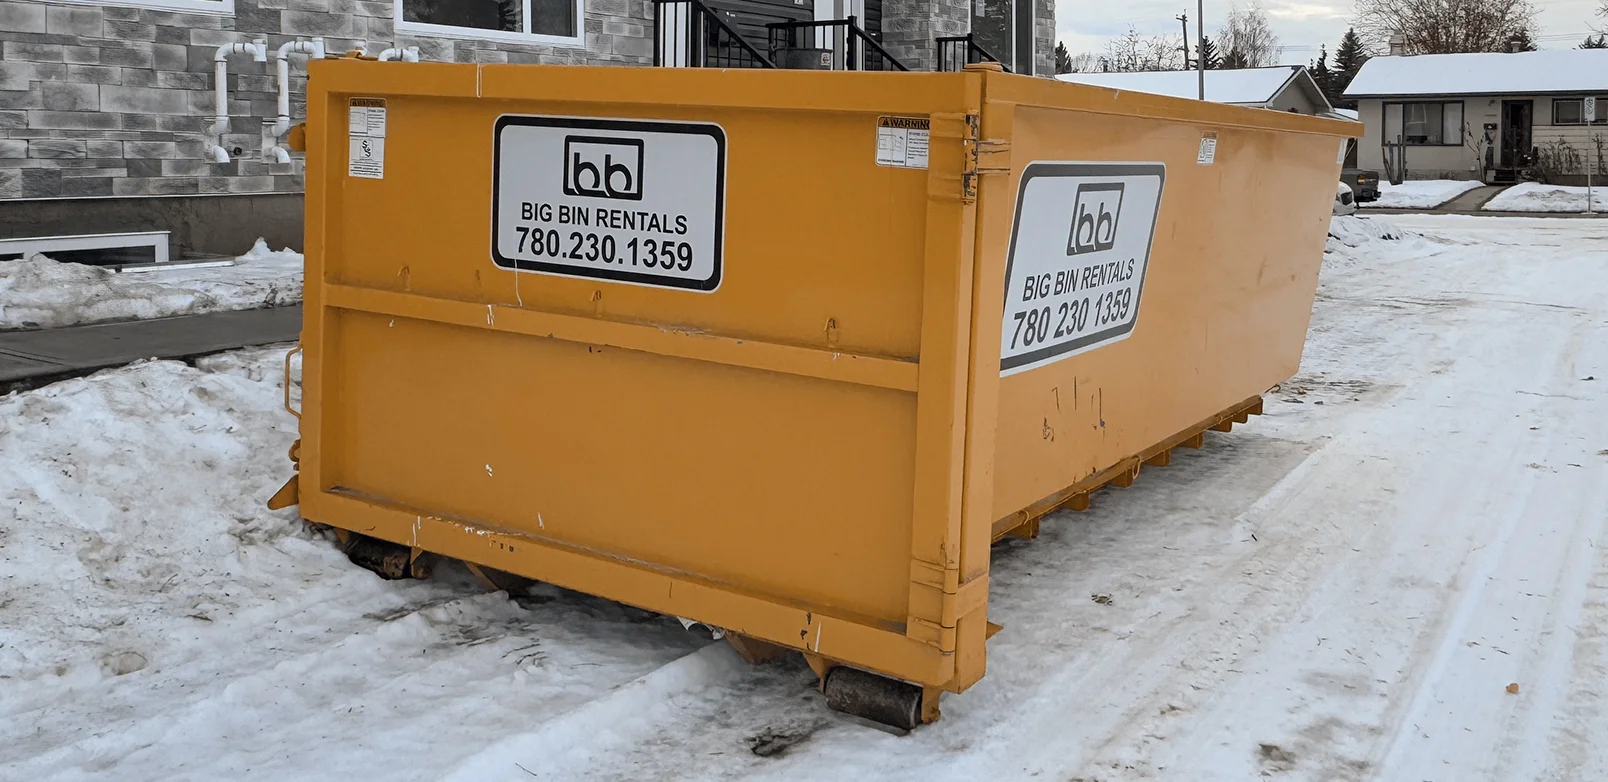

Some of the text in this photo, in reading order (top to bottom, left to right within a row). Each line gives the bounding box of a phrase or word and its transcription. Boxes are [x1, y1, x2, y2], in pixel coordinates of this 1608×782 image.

[521, 202, 688, 236] BIG BIN RENTALS
[515, 226, 693, 272] 780.230.1359
[1022, 257, 1135, 302] BIG BIN RENTALS
[1010, 287, 1132, 350] 780 230 1359
